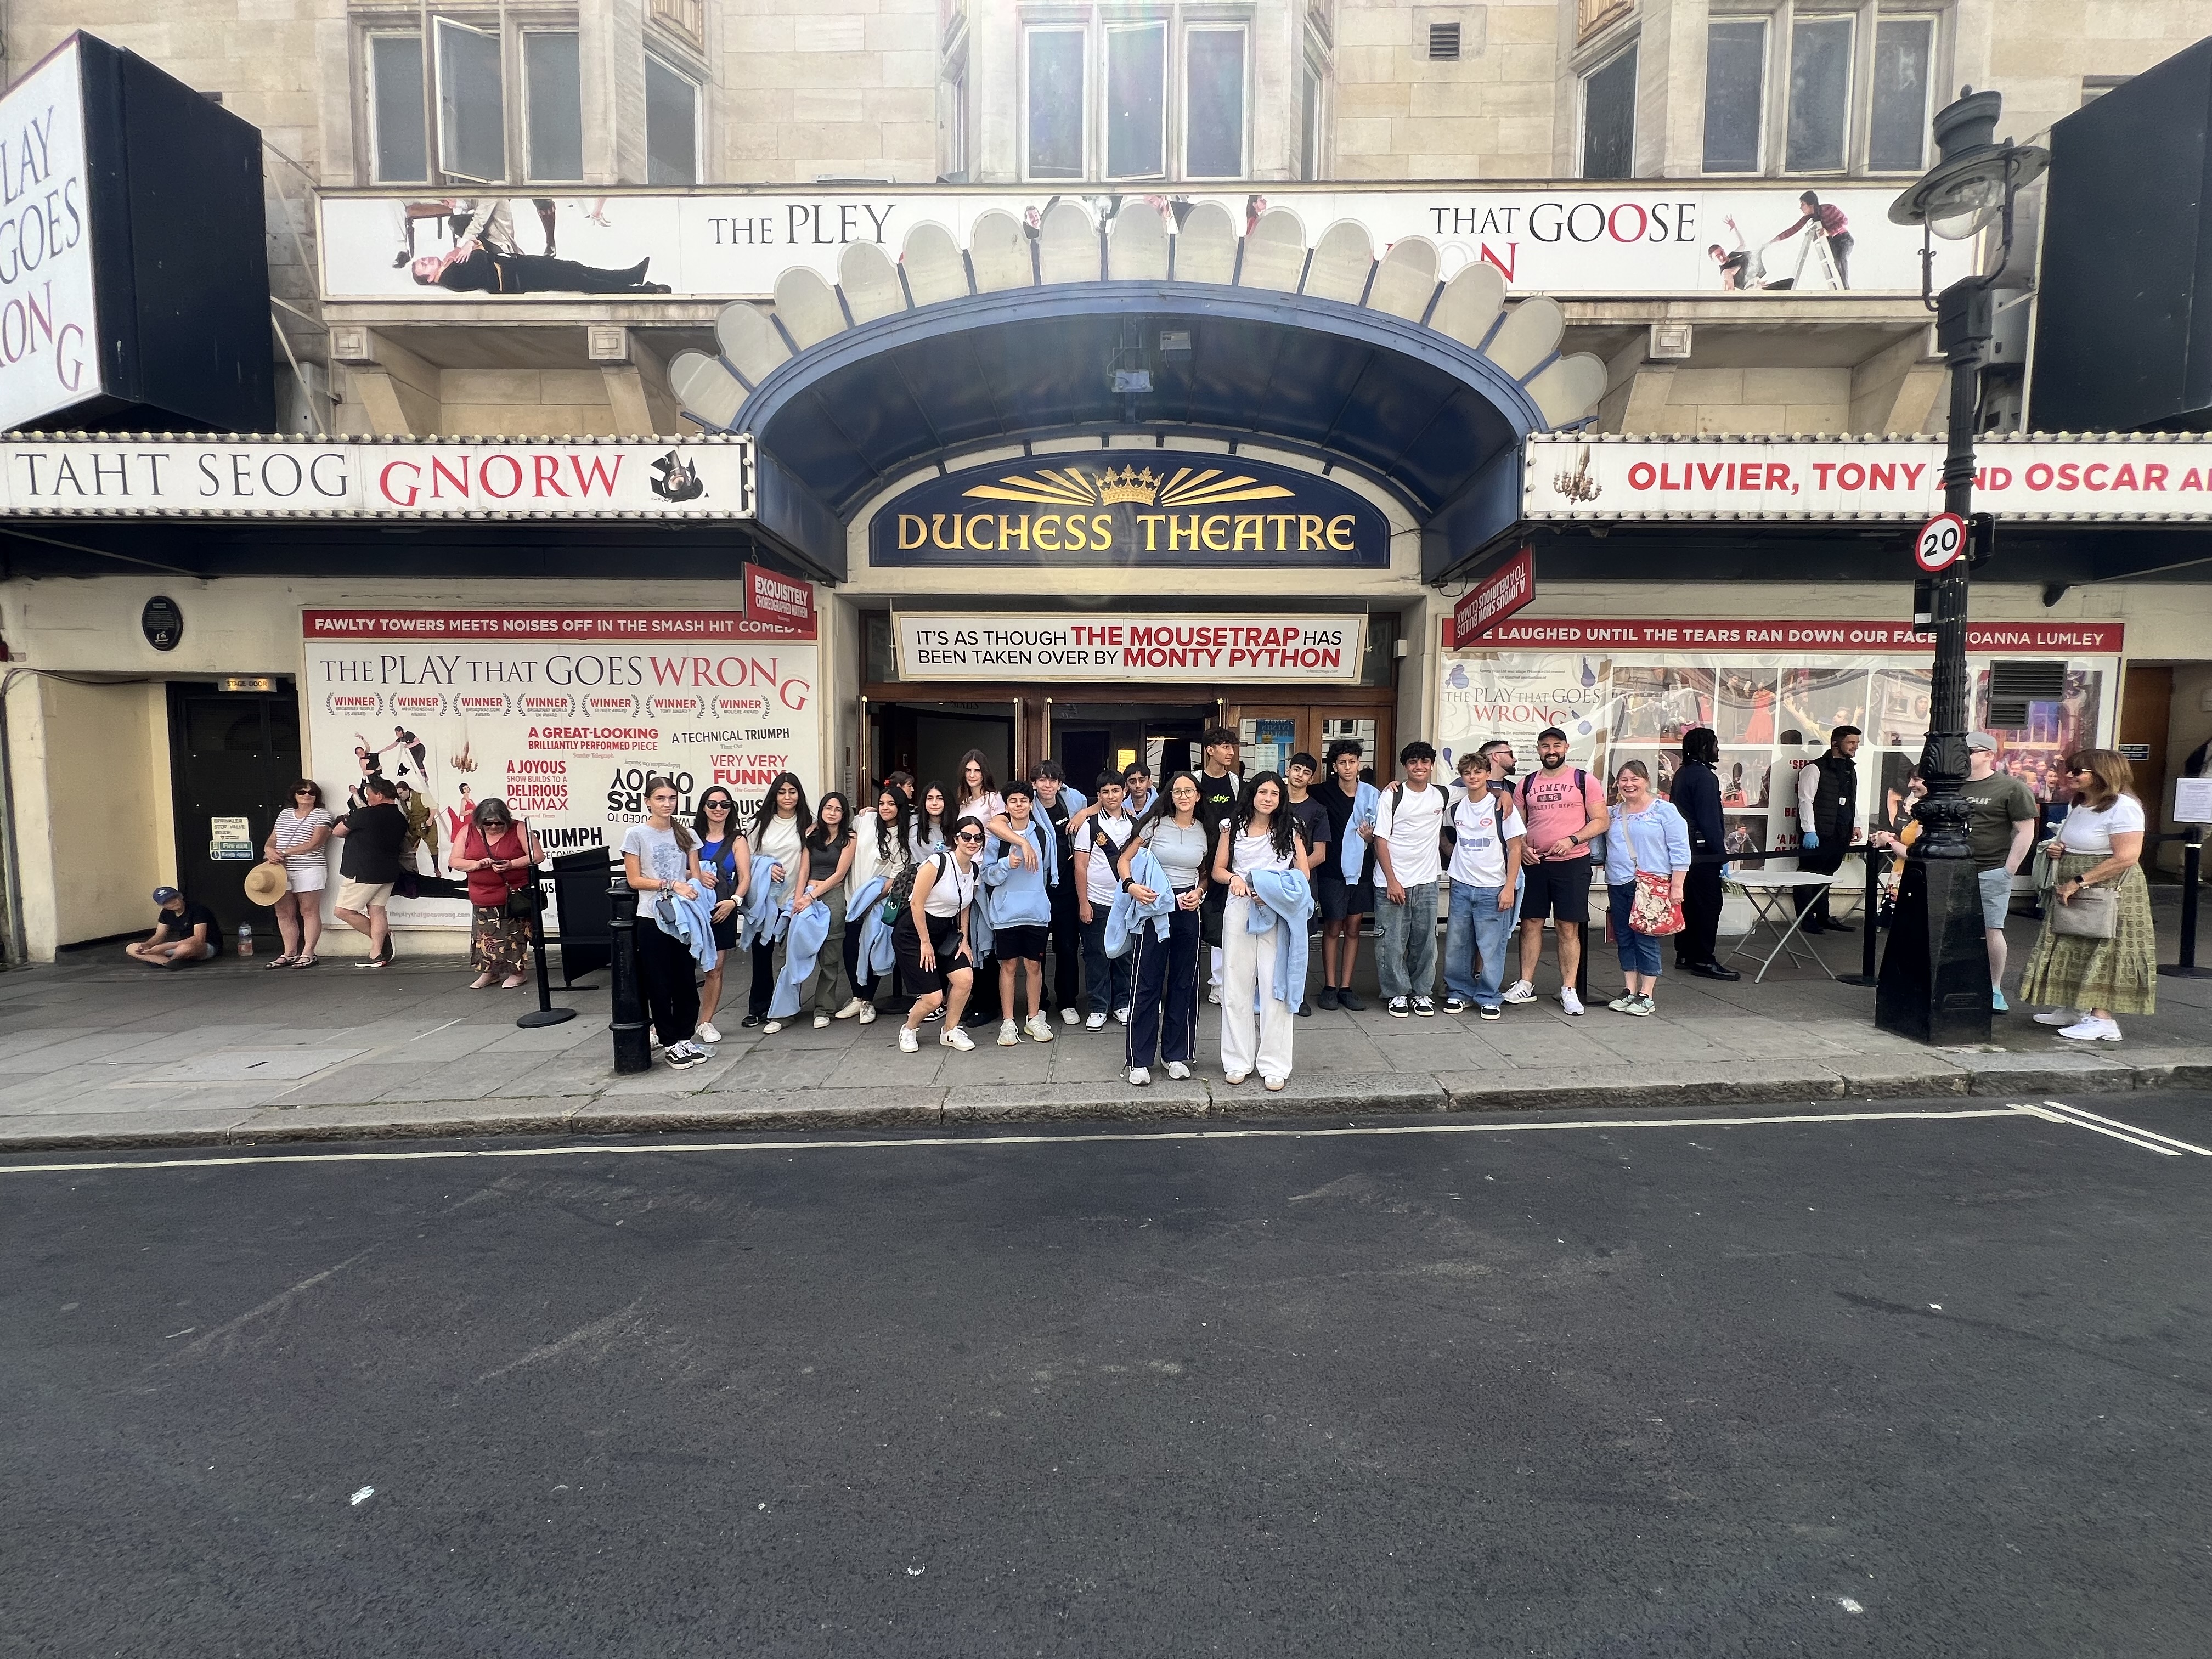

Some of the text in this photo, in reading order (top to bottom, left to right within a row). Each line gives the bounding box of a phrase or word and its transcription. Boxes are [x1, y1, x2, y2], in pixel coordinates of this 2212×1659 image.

[0, 105, 54, 207] LAY
[0, 177, 80, 284] GOES
[708, 217, 774, 245] THE
[1429, 203, 1696, 242] THAT GOOSE
[0, 279, 84, 392] ONG
[15, 453, 625, 507] TAHT SEOG GNORW
[1628, 462, 1799, 495] OLIVIER,
[1813, 462, 1927, 491] TONY
[1935, 467, 2012, 491] ND
[2025, 463, 2169, 492] OSCAR
[897, 514, 1356, 551] DUCHESS THEATRE
[1923, 527, 1957, 558] 20
[755, 575, 808, 606] EXQUISITELY
[1479, 574, 1509, 610] DELIRIOUS
[1497, 582, 1520, 612] JOYOUS
[1479, 600, 1496, 624] SHOW
[314, 618, 802, 633] FAWLTY TOWERS MEETS NOISES OFF IN THE SMASH HIT COMED
[1457, 614, 1478, 639] BUILDS
[917, 626, 1342, 647] IT'S AS THOUGH THE MOUSETRAP HAS
[1482, 629, 1493, 639] E
[1498, 628, 1581, 641] LAUGHED
[1587, 628, 1638, 641] UNTIL
[1644, 629, 1677, 641] THE
[1683, 629, 1740, 642] TEARS
[1746, 629, 1782, 642] RAN
[1788, 630, 1844, 642] DOWN
[1850, 630, 1888, 643] OUR
[1893, 631, 1937, 644] FACE
[2036, 633, 2104, 645] LUMLEY
[918, 648, 1341, 668] BEEN TAKEN OVER BY MONTY PYTHON
[319, 655, 811, 711] THE PLAY THAT GOES WRONG
[334, 697, 375, 706] WINNER
[397, 697, 438, 707] WINNER
[461, 698, 503, 707] WINNER
[526, 698, 567, 707] WINNER
[590, 698, 631, 708] WINNER
[654, 699, 697, 709] WINNER
[719, 699, 761, 709] WINNER
[1446, 687, 1601, 704] THE PLAY THAT GOES
[1473, 705, 1567, 726] WRONG
[528, 727, 659, 739] A GREAT-LOOKING
[672, 728, 790, 744] A TECHNICAL TRIUMPH
[528, 741, 658, 751] BRILLIANTLY PERFORMED PIECE
[506, 760, 566, 774] A JOYOUS
[710, 754, 788, 767] VERY VERY
[507, 784, 568, 797] DELIRIOUS
[506, 798, 569, 811] CLIMAX
[607, 791, 697, 816] TRS
[608, 813, 620, 822] TO
[622, 814, 652, 823] UCED
[532, 827, 603, 848] IUMPH
